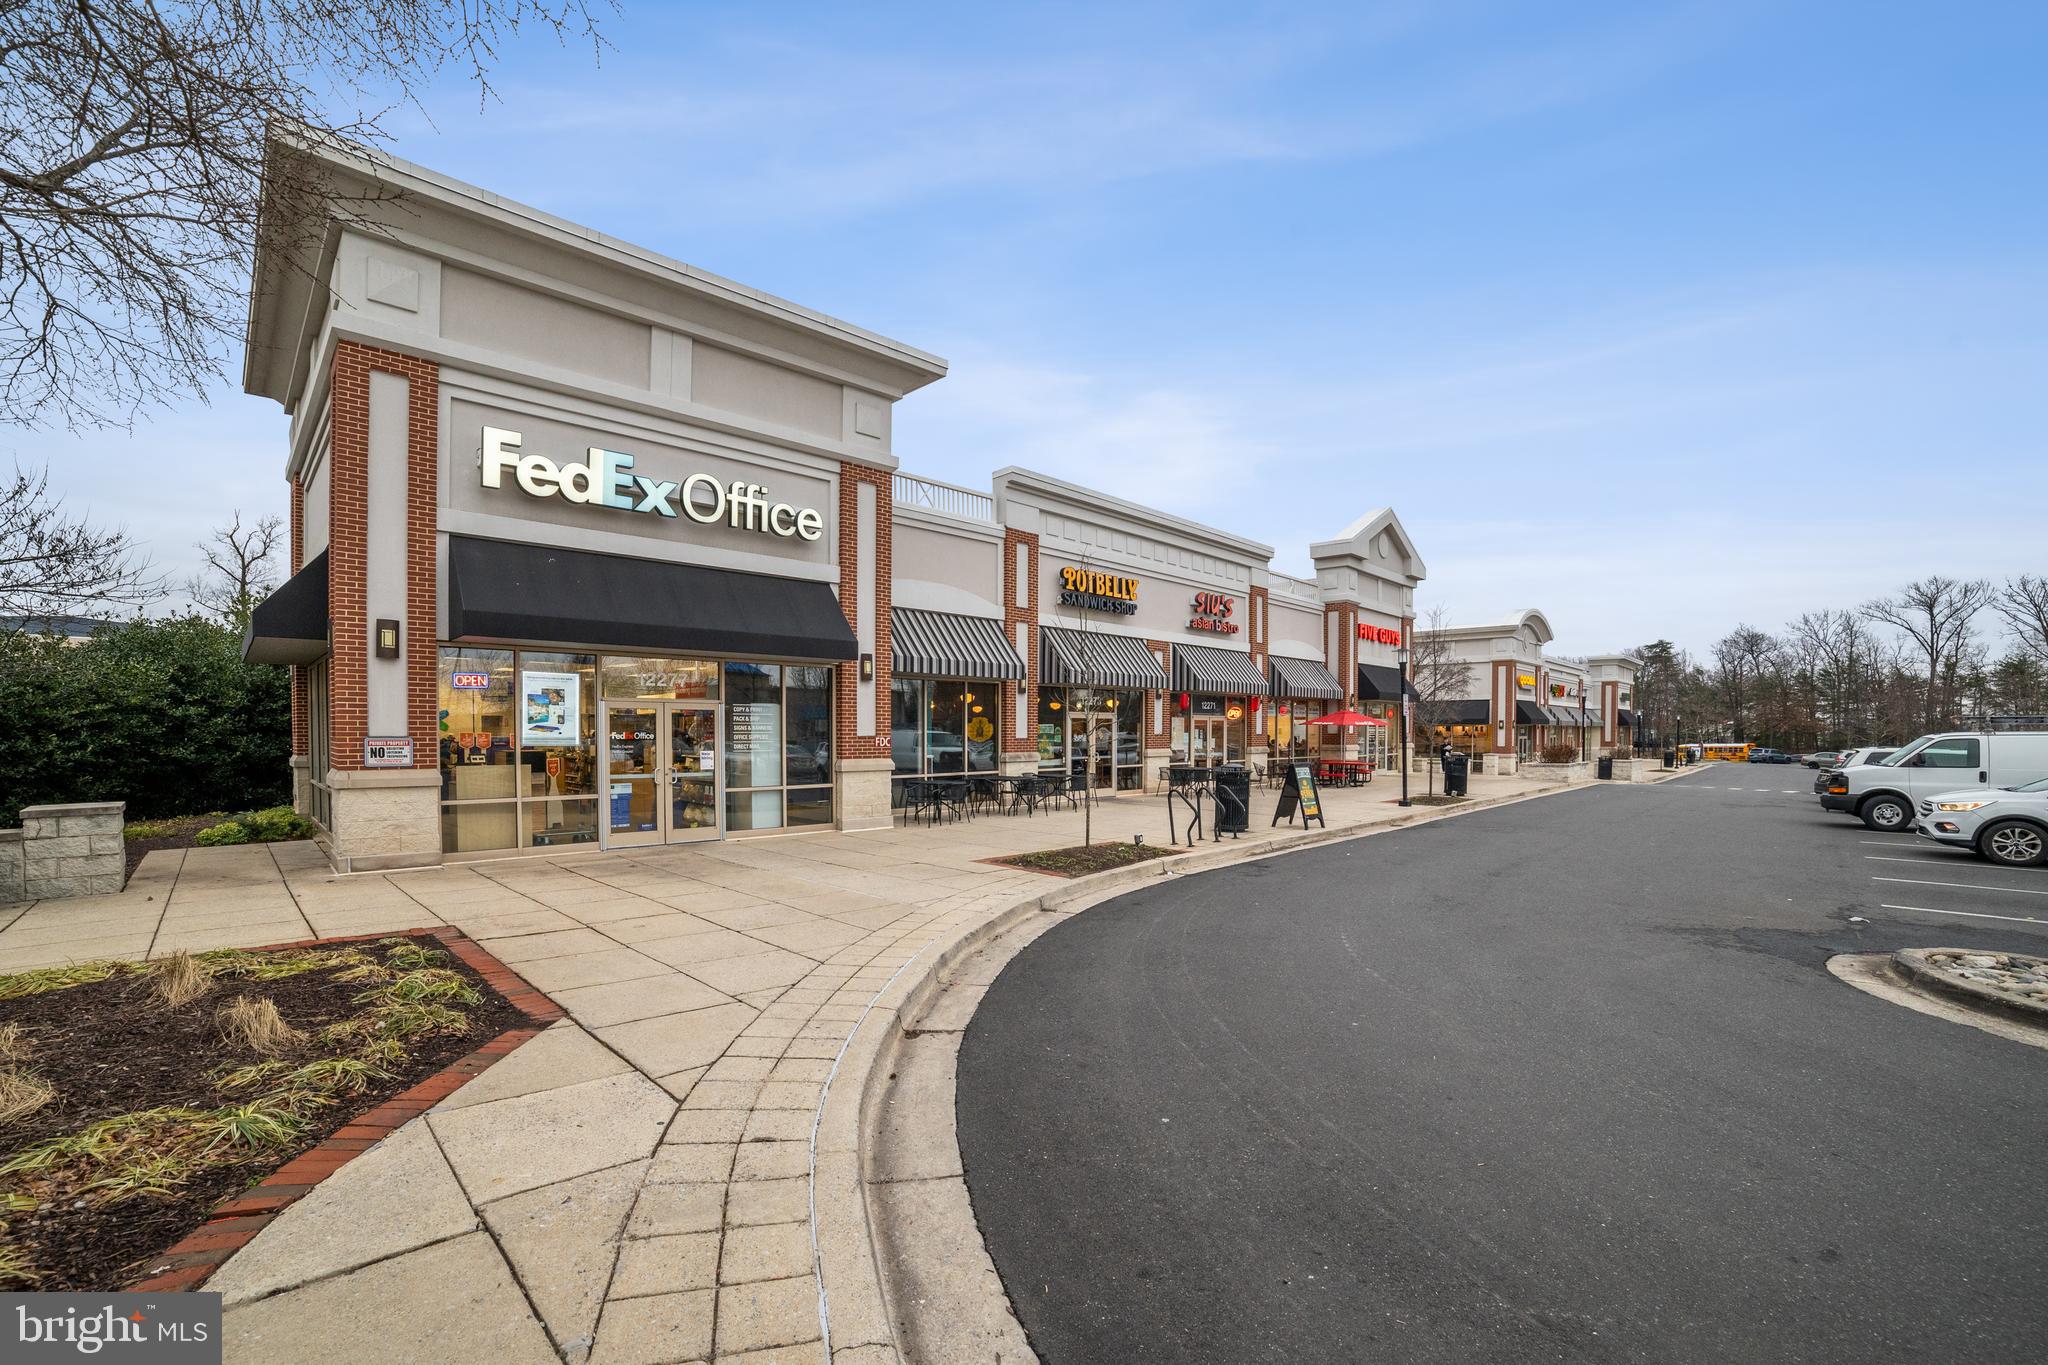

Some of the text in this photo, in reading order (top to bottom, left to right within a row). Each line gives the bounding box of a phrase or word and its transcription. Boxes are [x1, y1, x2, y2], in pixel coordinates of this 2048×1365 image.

[481, 425, 823, 541] FedEx Office
[1062, 566, 1139, 600] POTBELLY
[1063, 592, 1138, 615] SANDWICH SHOP
[1192, 617, 1239, 633] asian bistro
[1359, 623, 1400, 646] FIVE GUYS
[455, 675, 486, 686] OPEN
[640, 672, 688, 688] 12277
[1201, 702, 1216, 710] 12271
[611, 731, 654, 740] FedEx Office
[875, 737, 890, 746] FDC
[370, 747, 385, 758] NO
